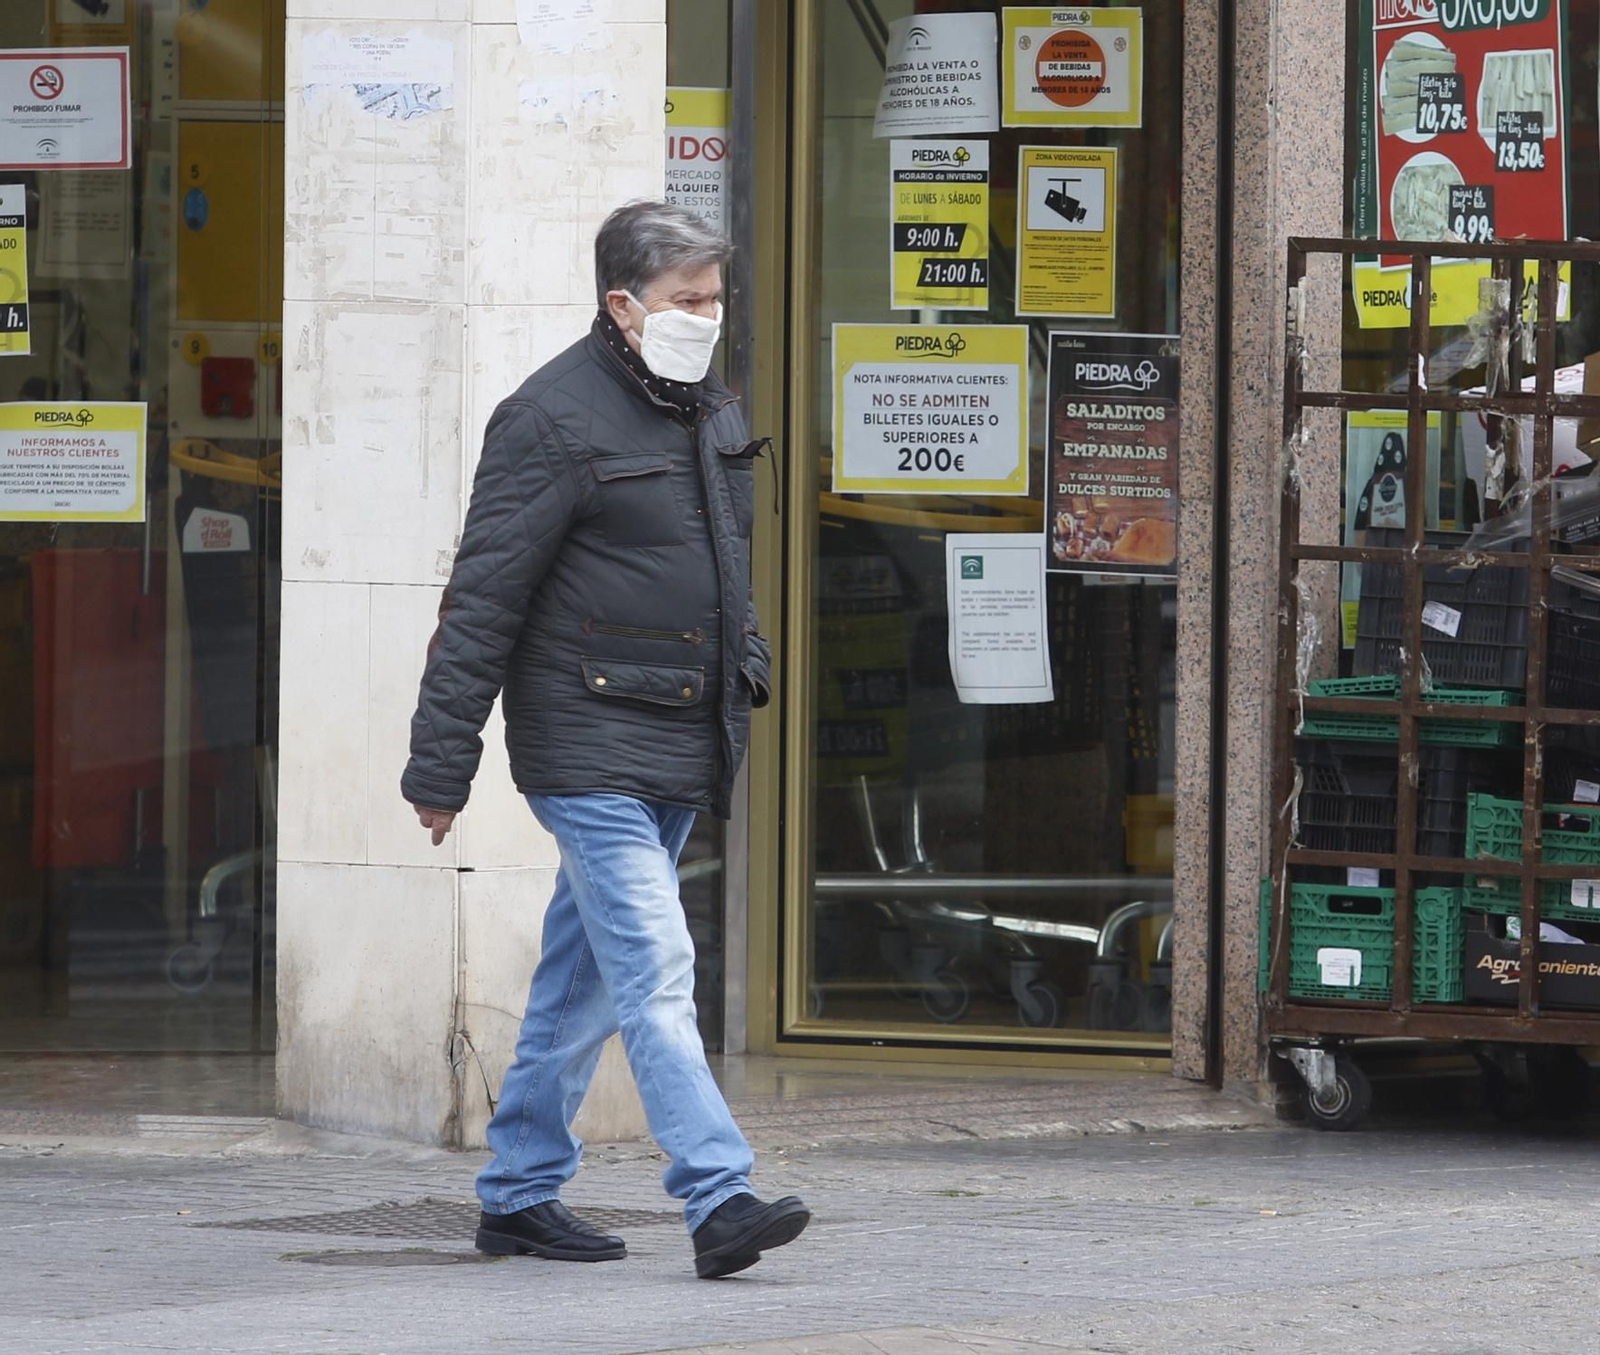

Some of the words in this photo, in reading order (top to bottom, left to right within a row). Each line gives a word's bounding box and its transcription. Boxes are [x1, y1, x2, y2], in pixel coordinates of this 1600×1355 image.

[917, 62, 928, 71] LA
[931, 61, 967, 70] VENTA
[970, 60, 979, 69] O
[920, 74, 933, 83] DE
[936, 72, 982, 82] BEBIDAS
[951, 86, 959, 94] A
[915, 99, 928, 108] DE
[930, 98, 940, 107] 18
[1361, 104, 1368, 118] de
[1419, 103, 1468, 133] 10,75€
[1360, 137, 1368, 147] al
[1498, 141, 1545, 172] 13,50€
[191, 165, 199, 179] 5
[946, 173, 983, 181] INVIERNO
[684, 197, 721, 206] ESTOS
[900, 193, 911, 204] DE
[913, 193, 937, 204] LUNES
[940, 194, 946, 204] A
[948, 191, 981, 204] SÁBADO
[907, 228, 940, 246] 9:00
[943, 227, 959, 247] h.
[924, 264, 967, 282] 21:00
[970, 262, 985, 283] h.
[7, 307, 24, 327] h.
[191, 340, 200, 354] 9
[263, 342, 278, 357] 10
[854, 375, 881, 384] NOTA
[884, 375, 954, 384] INFORMATIVA
[957, 376, 1009, 385] CLIENTES:
[872, 394, 894, 407] NO
[899, 395, 917, 407] SE
[921, 395, 990, 408] ADMITEN
[1066, 403, 1166, 420] SALADITOS
[863, 413, 923, 425] BILLETES
[927, 414, 984, 426] IGUALES
[988, 415, 999, 426] O
[1087, 422, 1104, 430] POR
[1106, 423, 1146, 432] ENCARGO
[21, 438, 95, 447] INFORMAMOS
[98, 439, 106, 447] A
[883, 432, 965, 444] SUPERIORES
[969, 433, 979, 444] A
[7, 448, 65, 457] NUESTROS
[68, 448, 120, 457] CLIENTES
[1063, 443, 1168, 460] EMPANADAS
[897, 447, 965, 472] 200€
[1078, 473, 1102, 482] GRAN
[1104, 474, 1148, 483] VARIEDAD
[1150, 475, 1161, 484] DE
[1058, 484, 1106, 496] DULCES
[1110, 485, 1171, 498] SURTIDOS
